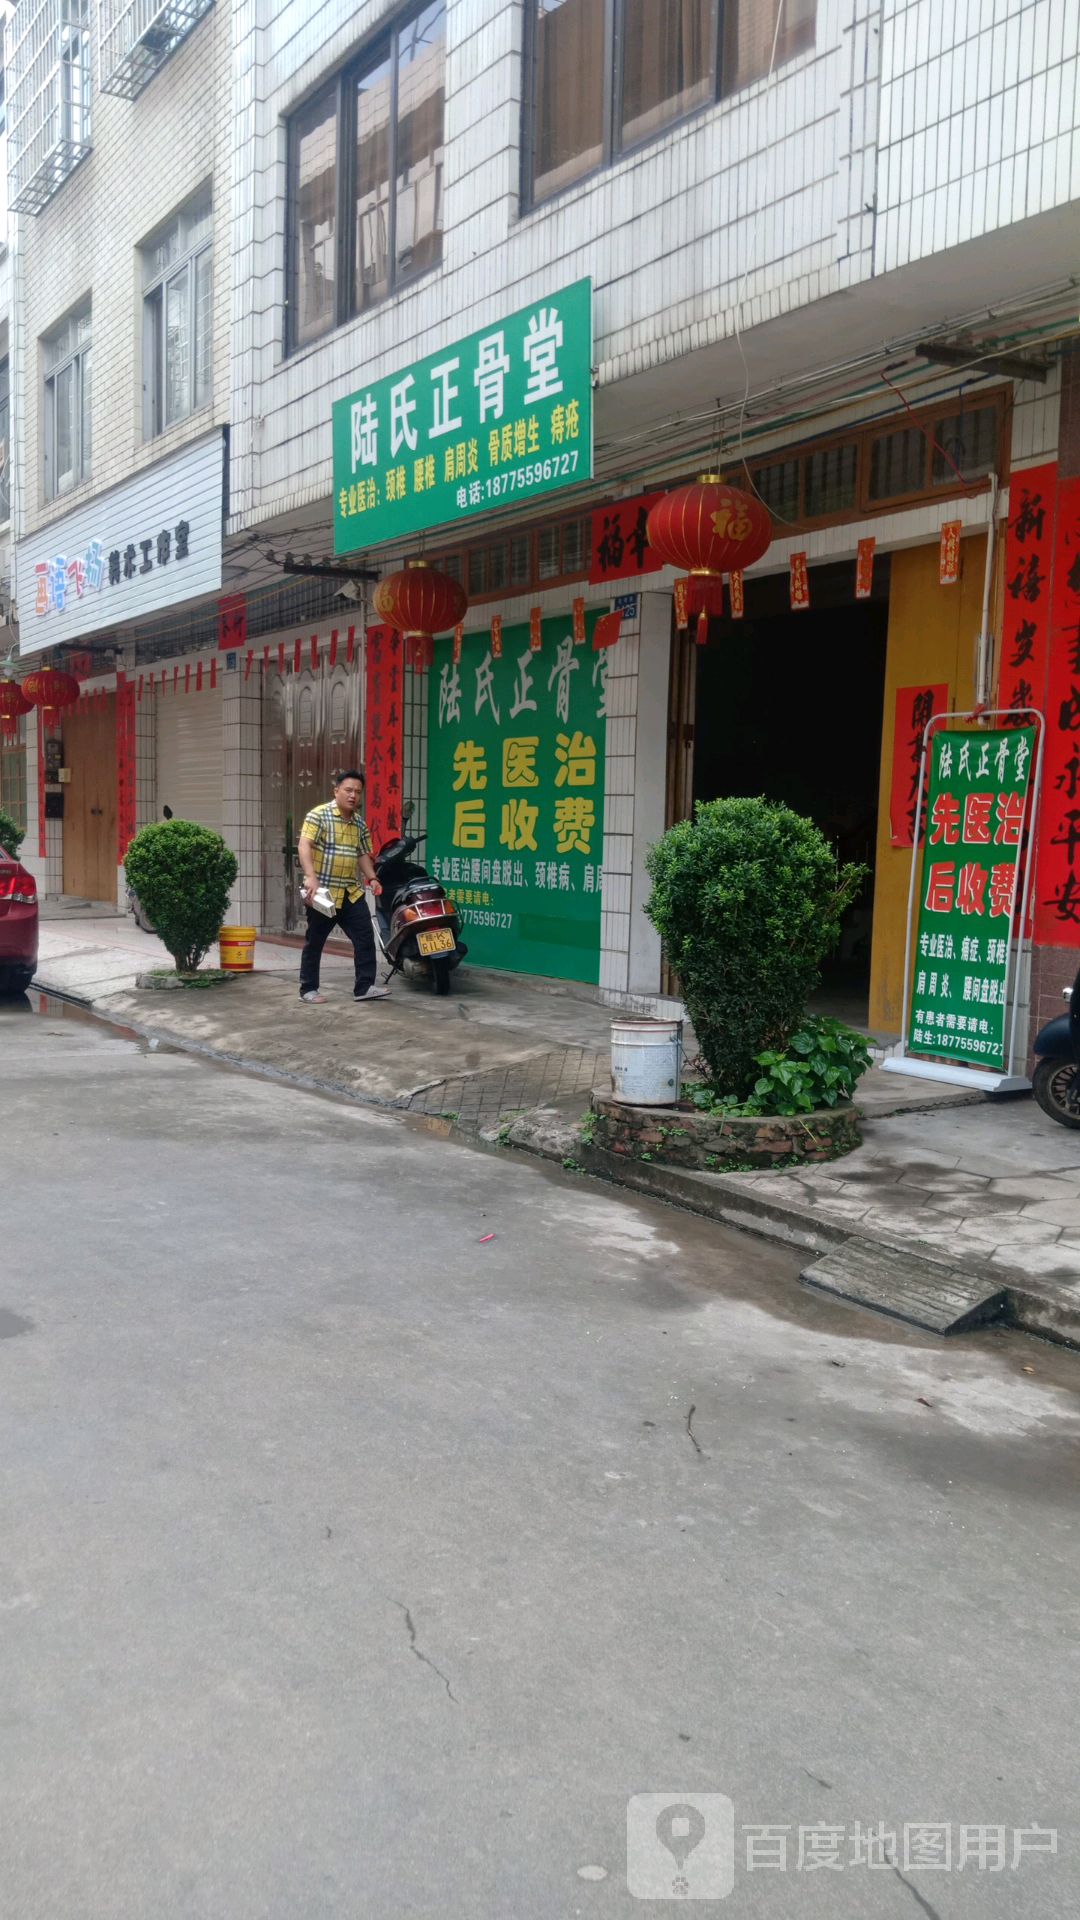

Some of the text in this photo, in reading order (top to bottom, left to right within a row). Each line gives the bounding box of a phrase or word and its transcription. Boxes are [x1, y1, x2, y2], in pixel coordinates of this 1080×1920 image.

[350, 307, 564, 475] 陆氏正骨堂
[385, 465, 406, 502] 颈椎
[413, 454, 436, 492] 腰椎
[444, 437, 479, 483] 肩周炎
[488, 415, 540, 468] 骨质增生
[456, 450, 579, 509] 电话:18775596727
[709, 497, 753, 541] 福
[108, 519, 190, 586] 美术工作室
[452, 730, 596, 791] 先医治
[938, 735, 1030, 783] 陆氏正骨堂
[452, 796, 596, 855] 后收费
[928, 791, 1025, 846] 先医治
[924, 861, 1019, 919] 后收费
[919, 931, 1009, 966] 专业医治、痛症、颈椎
[915, 1008, 994, 1035] 有患者需要请电:
